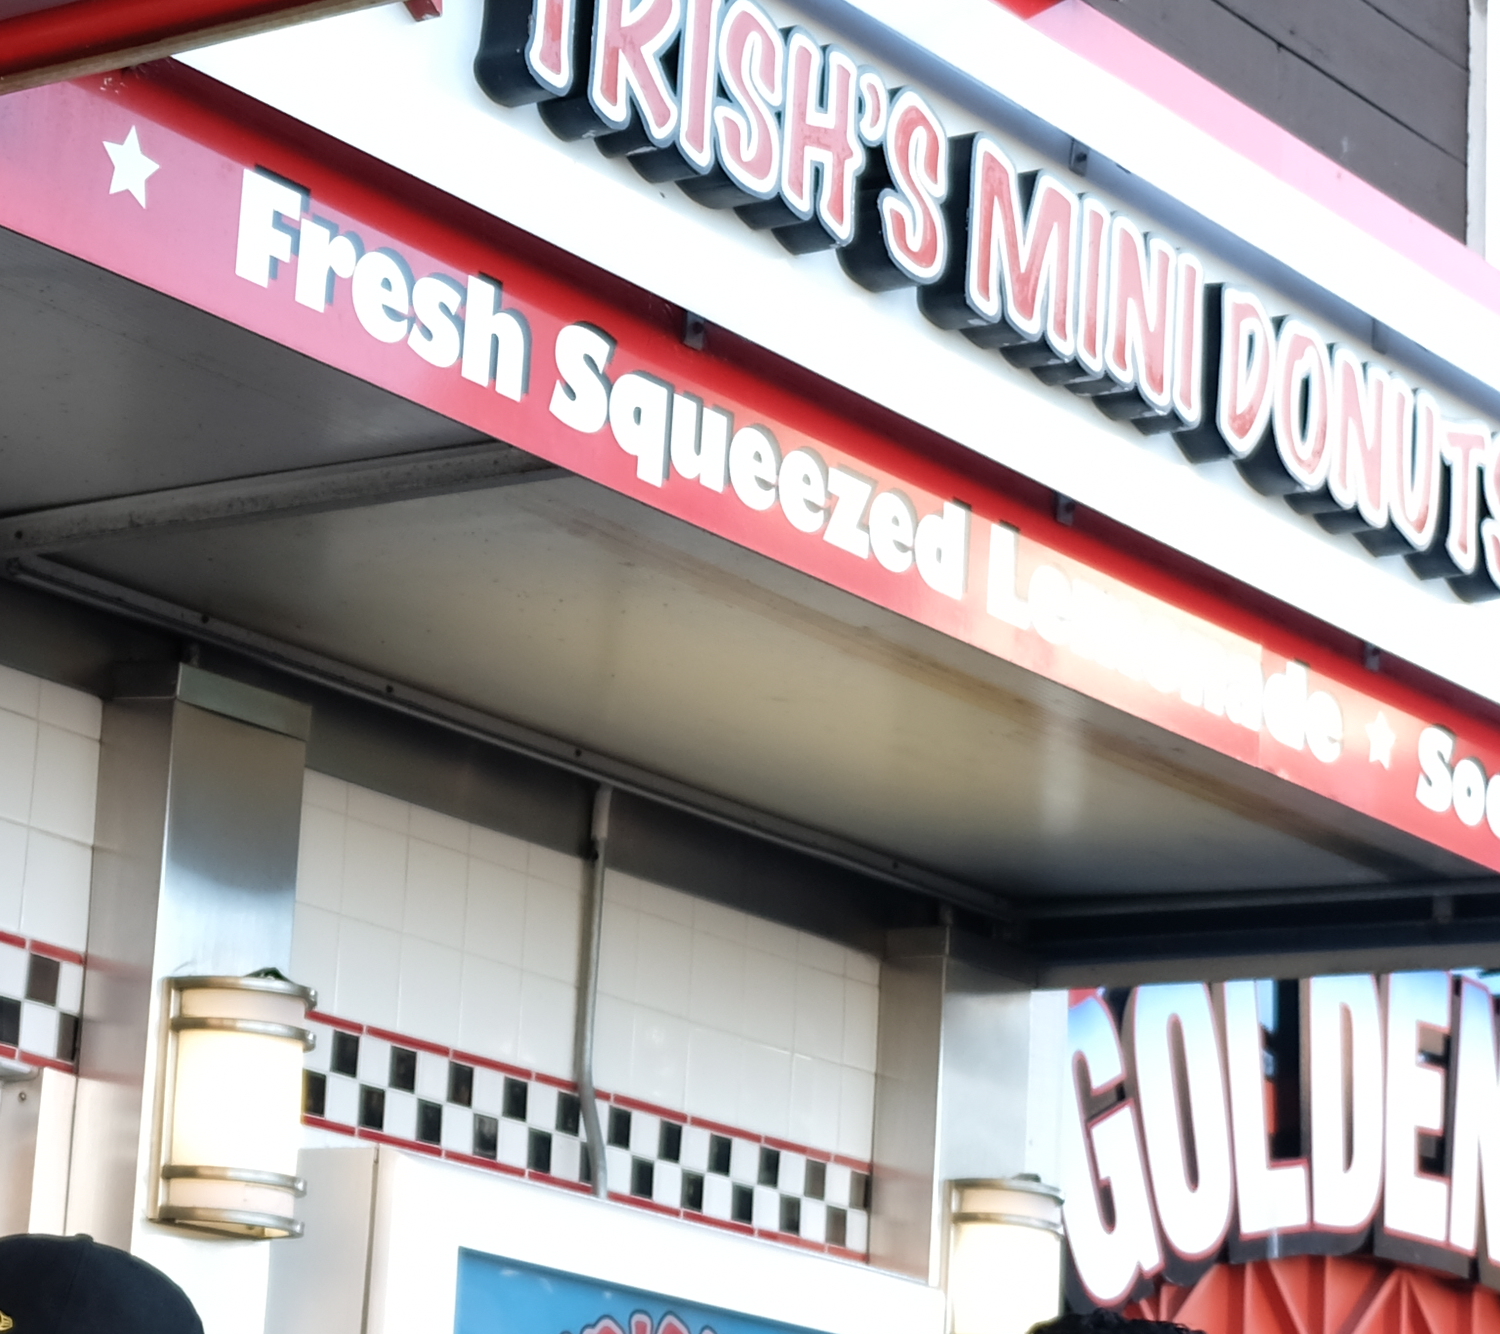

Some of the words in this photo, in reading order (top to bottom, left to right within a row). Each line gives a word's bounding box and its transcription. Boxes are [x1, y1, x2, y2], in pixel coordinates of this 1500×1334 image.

[234, 167, 531, 403] Fresh
[548, 320, 971, 601] Squeezed
[966, 131, 1204, 424] MINI
